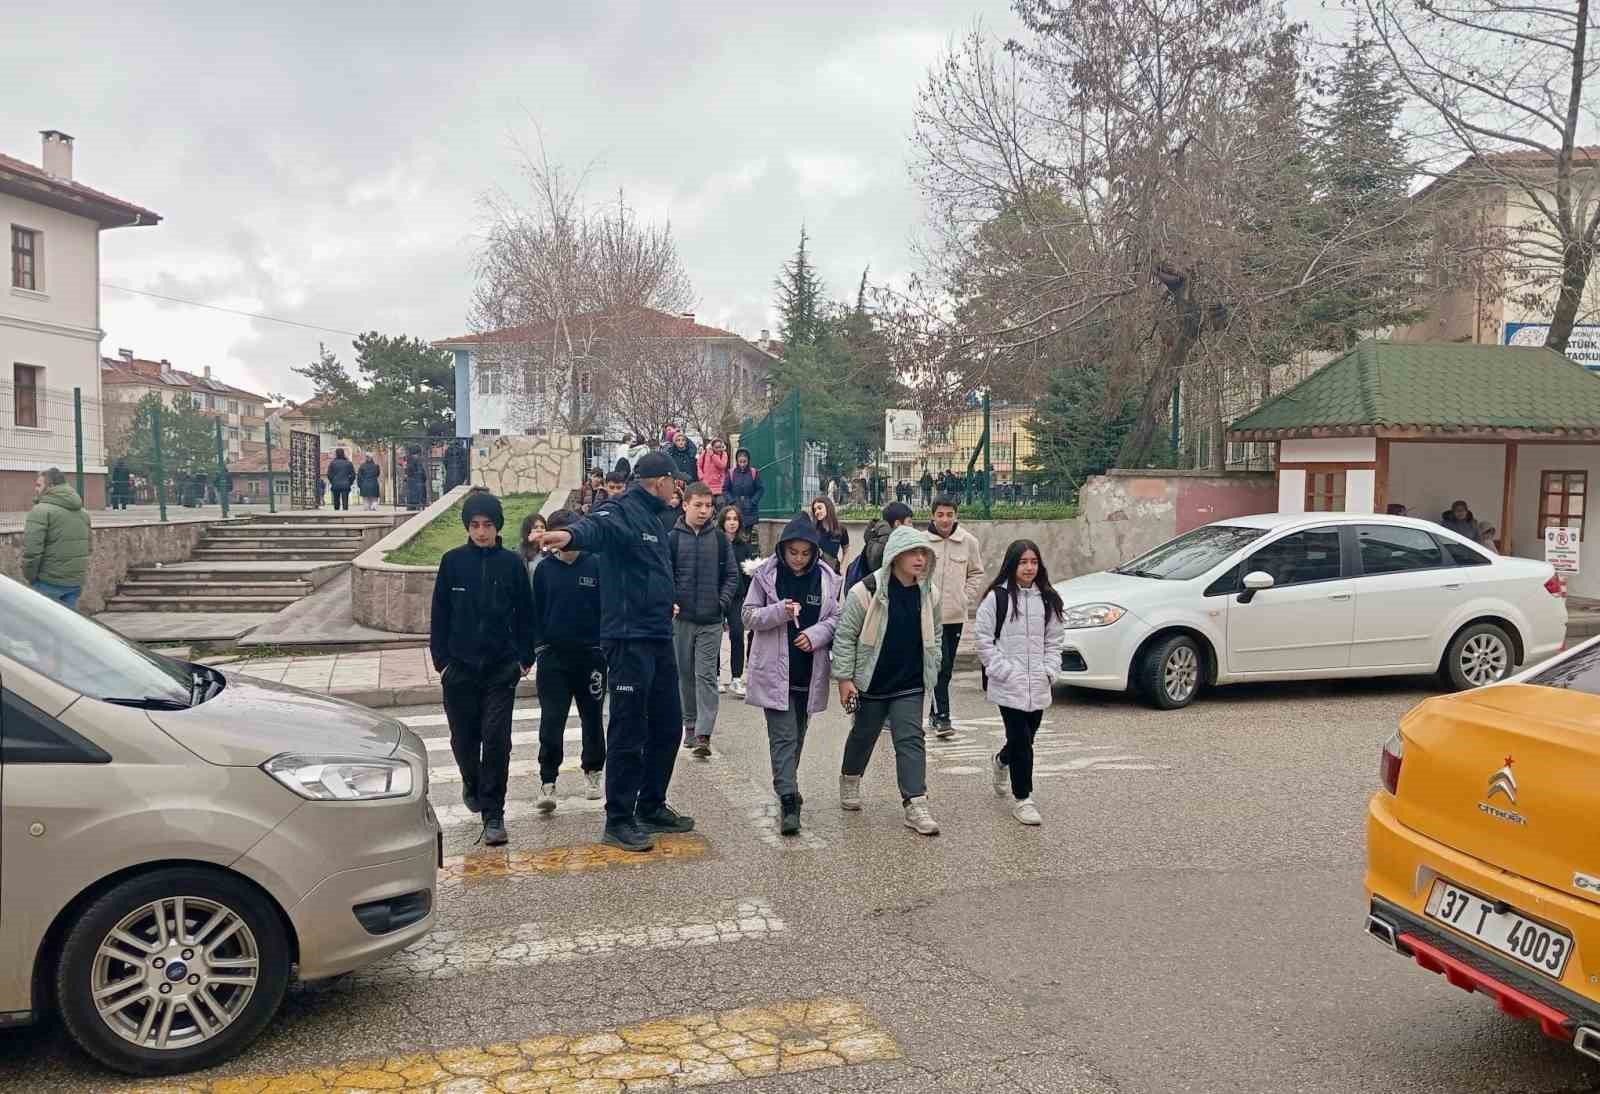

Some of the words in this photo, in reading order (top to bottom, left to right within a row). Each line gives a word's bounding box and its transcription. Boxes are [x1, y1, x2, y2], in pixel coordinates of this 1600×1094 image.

[1441, 890, 1469, 923] 37
[1476, 904, 1492, 935] T
[1507, 920, 1565, 970] 4003
